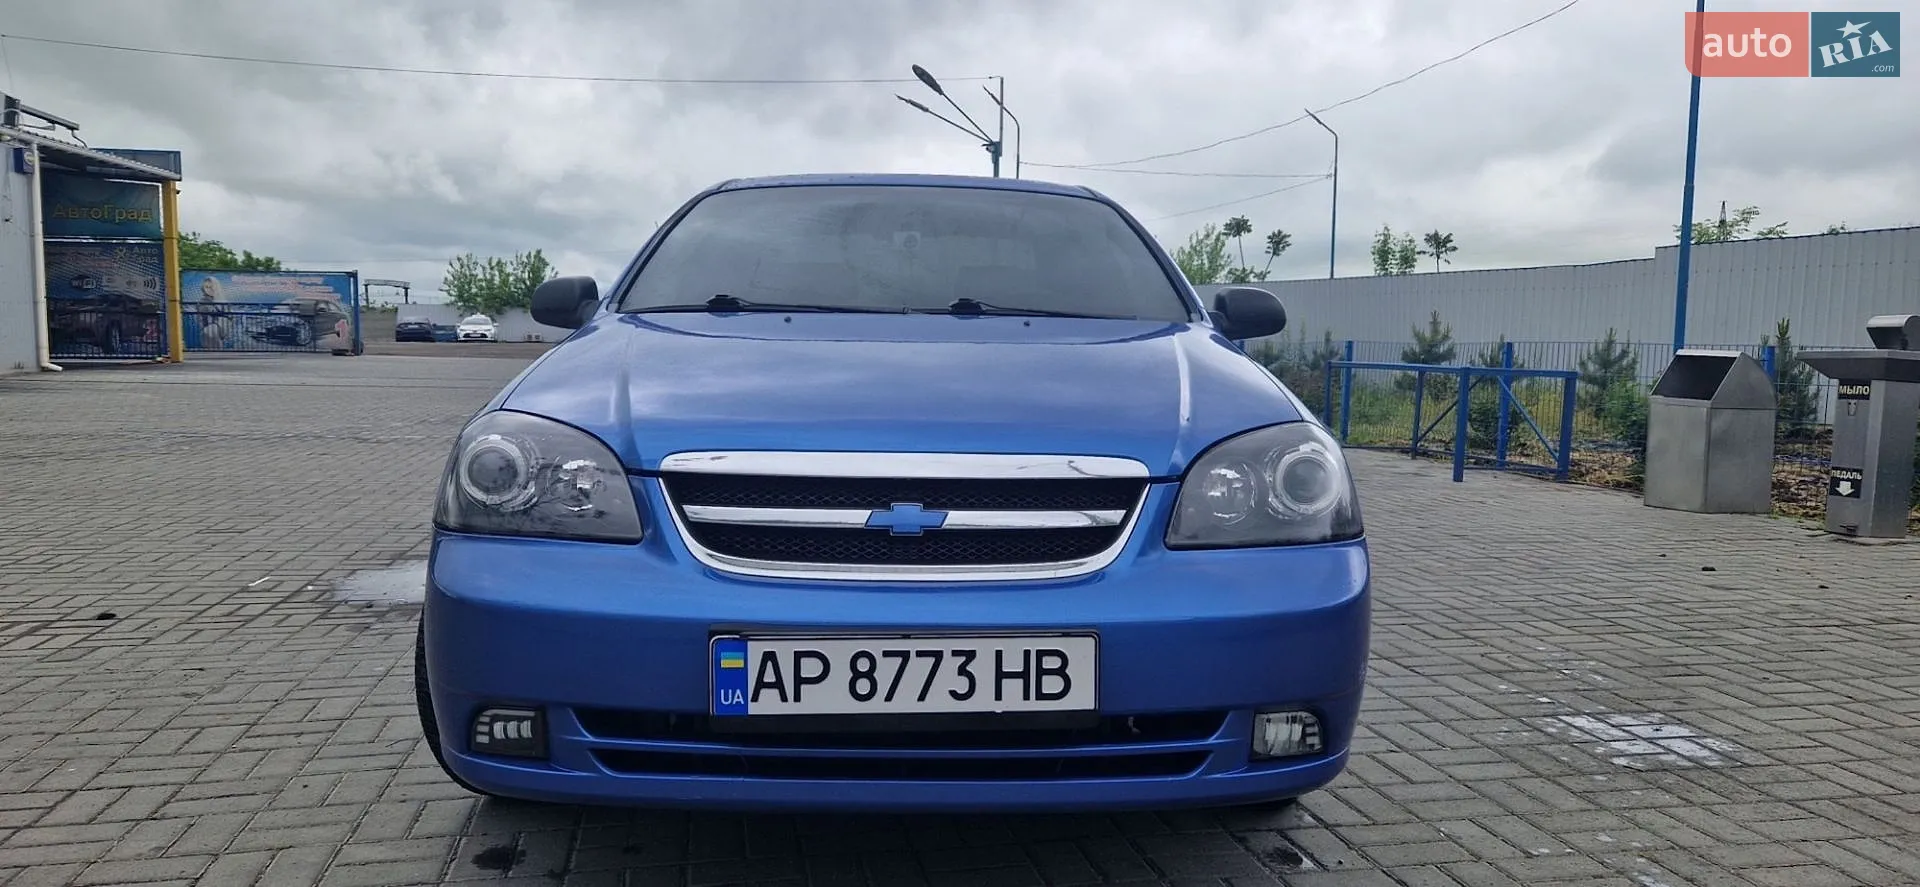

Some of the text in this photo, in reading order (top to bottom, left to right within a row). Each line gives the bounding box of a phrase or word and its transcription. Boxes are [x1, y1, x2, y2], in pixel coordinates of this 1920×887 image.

[52, 203, 153, 224] АвтоГрад
[1838, 385, 1870, 396] МЫЛО
[1831, 469, 1863, 480] ПЕДАЛЬ
[750, 648, 1072, 703] AP 8773 HB
[720, 689, 744, 705] UA
